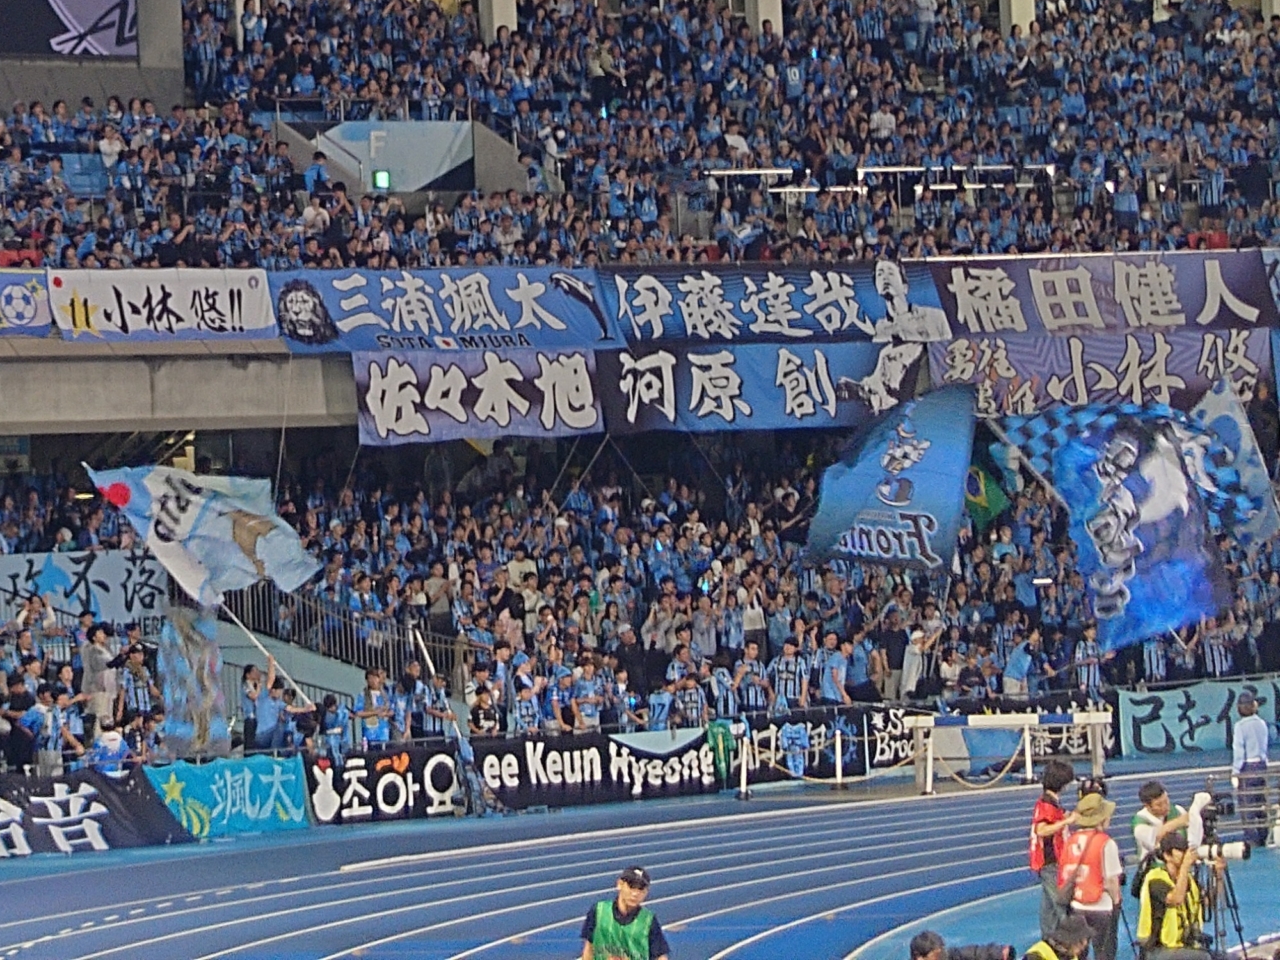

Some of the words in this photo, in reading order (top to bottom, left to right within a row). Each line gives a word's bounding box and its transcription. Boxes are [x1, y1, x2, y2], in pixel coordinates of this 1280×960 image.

[331, 270, 568, 334] 三浦颯太
[614, 270, 876, 340] 伊藤達哉
[947, 259, 1261, 334] 橘田健人
[458, 332, 531, 350] MIURA
[366, 351, 598, 439] 佐々木旭
[619, 346, 837, 424] 河原創
[525, 740, 602, 786] Keun
